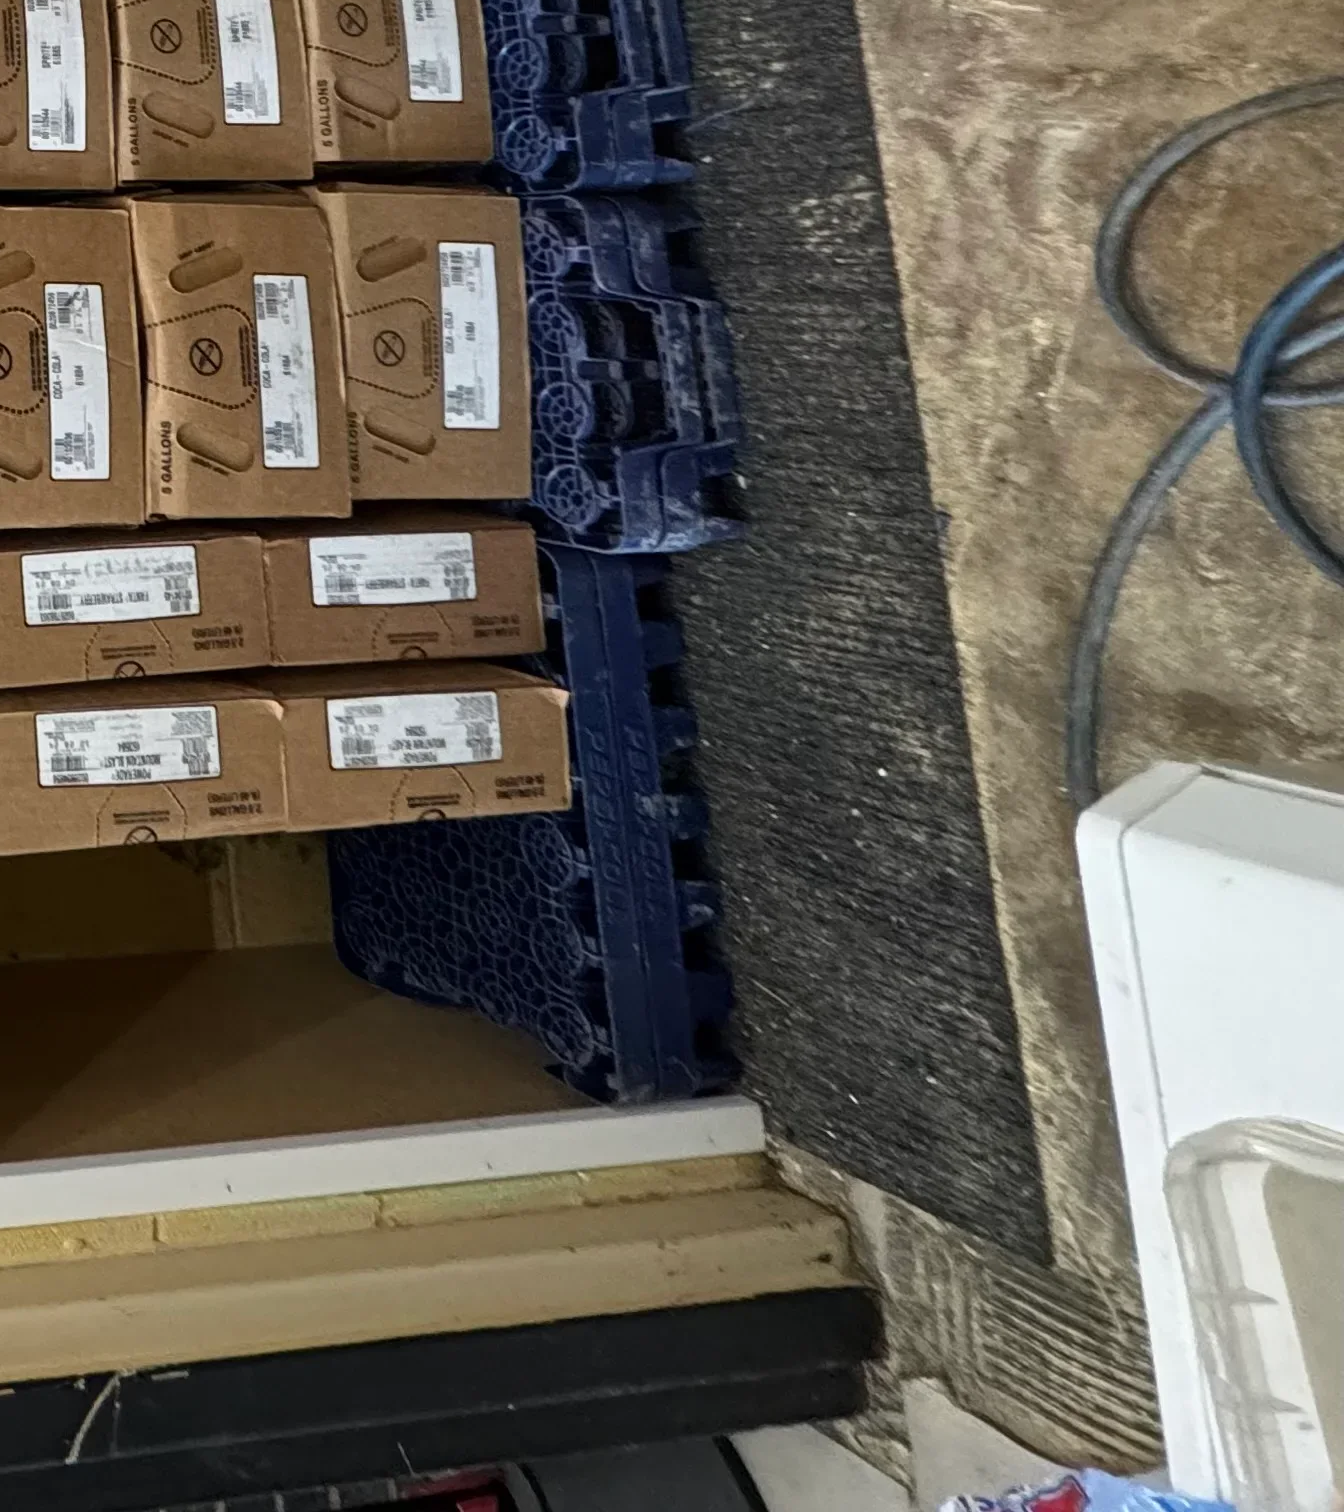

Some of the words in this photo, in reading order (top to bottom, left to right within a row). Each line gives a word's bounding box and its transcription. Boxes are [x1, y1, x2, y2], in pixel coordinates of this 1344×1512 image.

[127, 97, 140, 156] GALLONS
[317, 80, 332, 136] GALLONS
[323, 140, 334, 148] 5
[160, 421, 172, 483] GALLONS
[346, 411, 359, 472] GALLONS
[161, 487, 172, 495] 5
